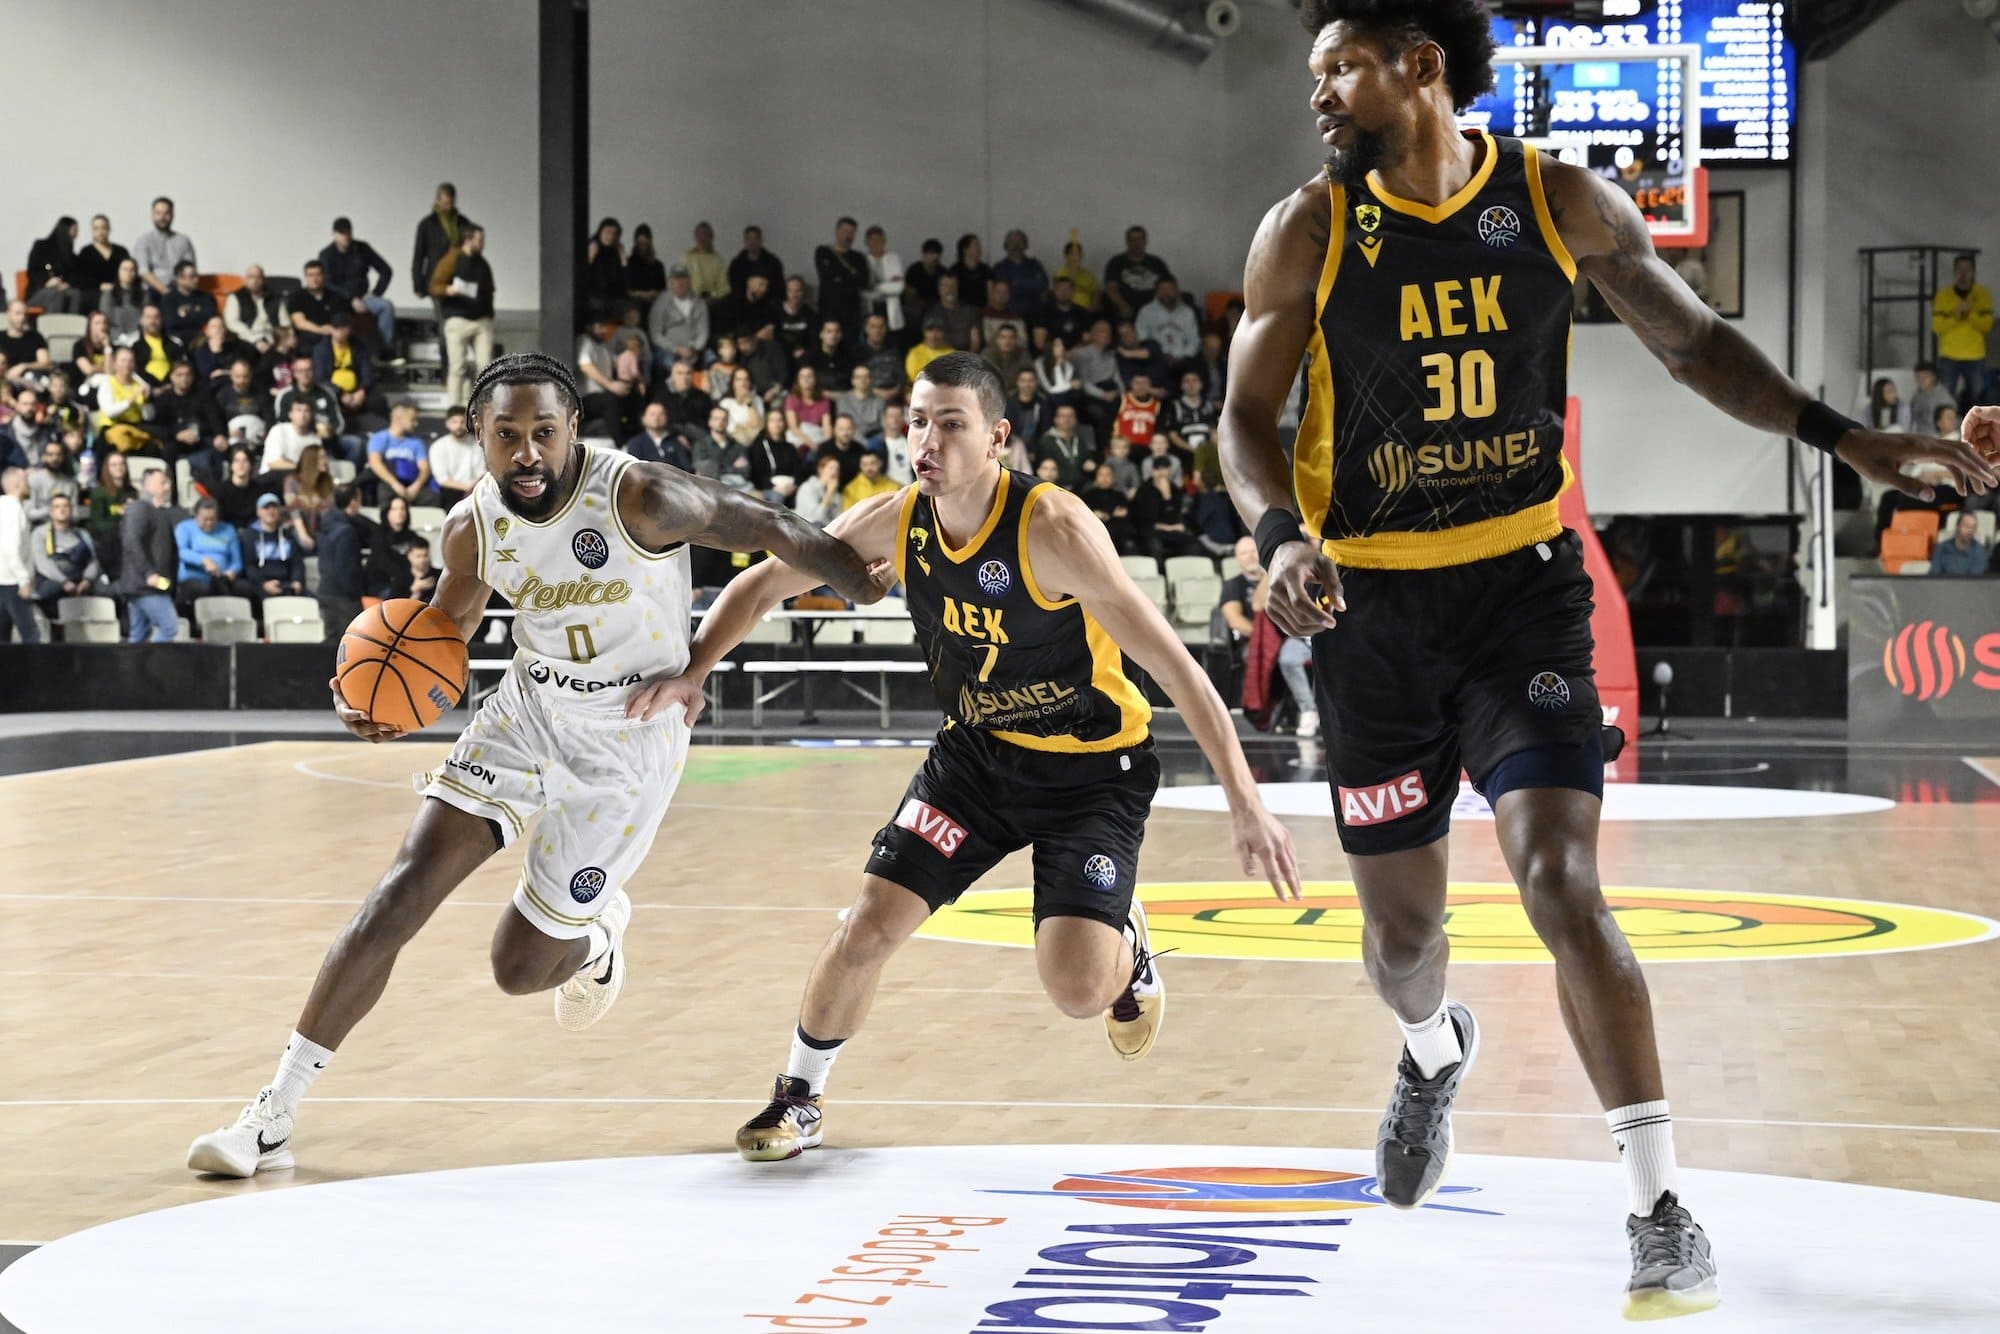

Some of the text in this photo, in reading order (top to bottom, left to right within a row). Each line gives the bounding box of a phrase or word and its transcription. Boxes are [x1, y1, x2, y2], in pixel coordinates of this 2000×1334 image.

[1400, 274, 1509, 342] AEK
[1421, 349, 1497, 422] 30
[1416, 428, 1541, 475] SUNEL
[1417, 471, 1503, 489] Empowering
[505, 573, 632, 613] Levice
[943, 596, 1010, 644] AEK
[565, 623, 597, 665] 0
[971, 644, 999, 683] 7
[976, 681, 1075, 715] SUNEL
[986, 693, 1080, 726] mpowering Change
[445, 759, 496, 786] LEON
[1344, 775, 1424, 821] AVIS
[969, 1218, 1353, 1334] Volta
[794, 1293, 893, 1306] z
[743, 1313, 868, 1334] p
